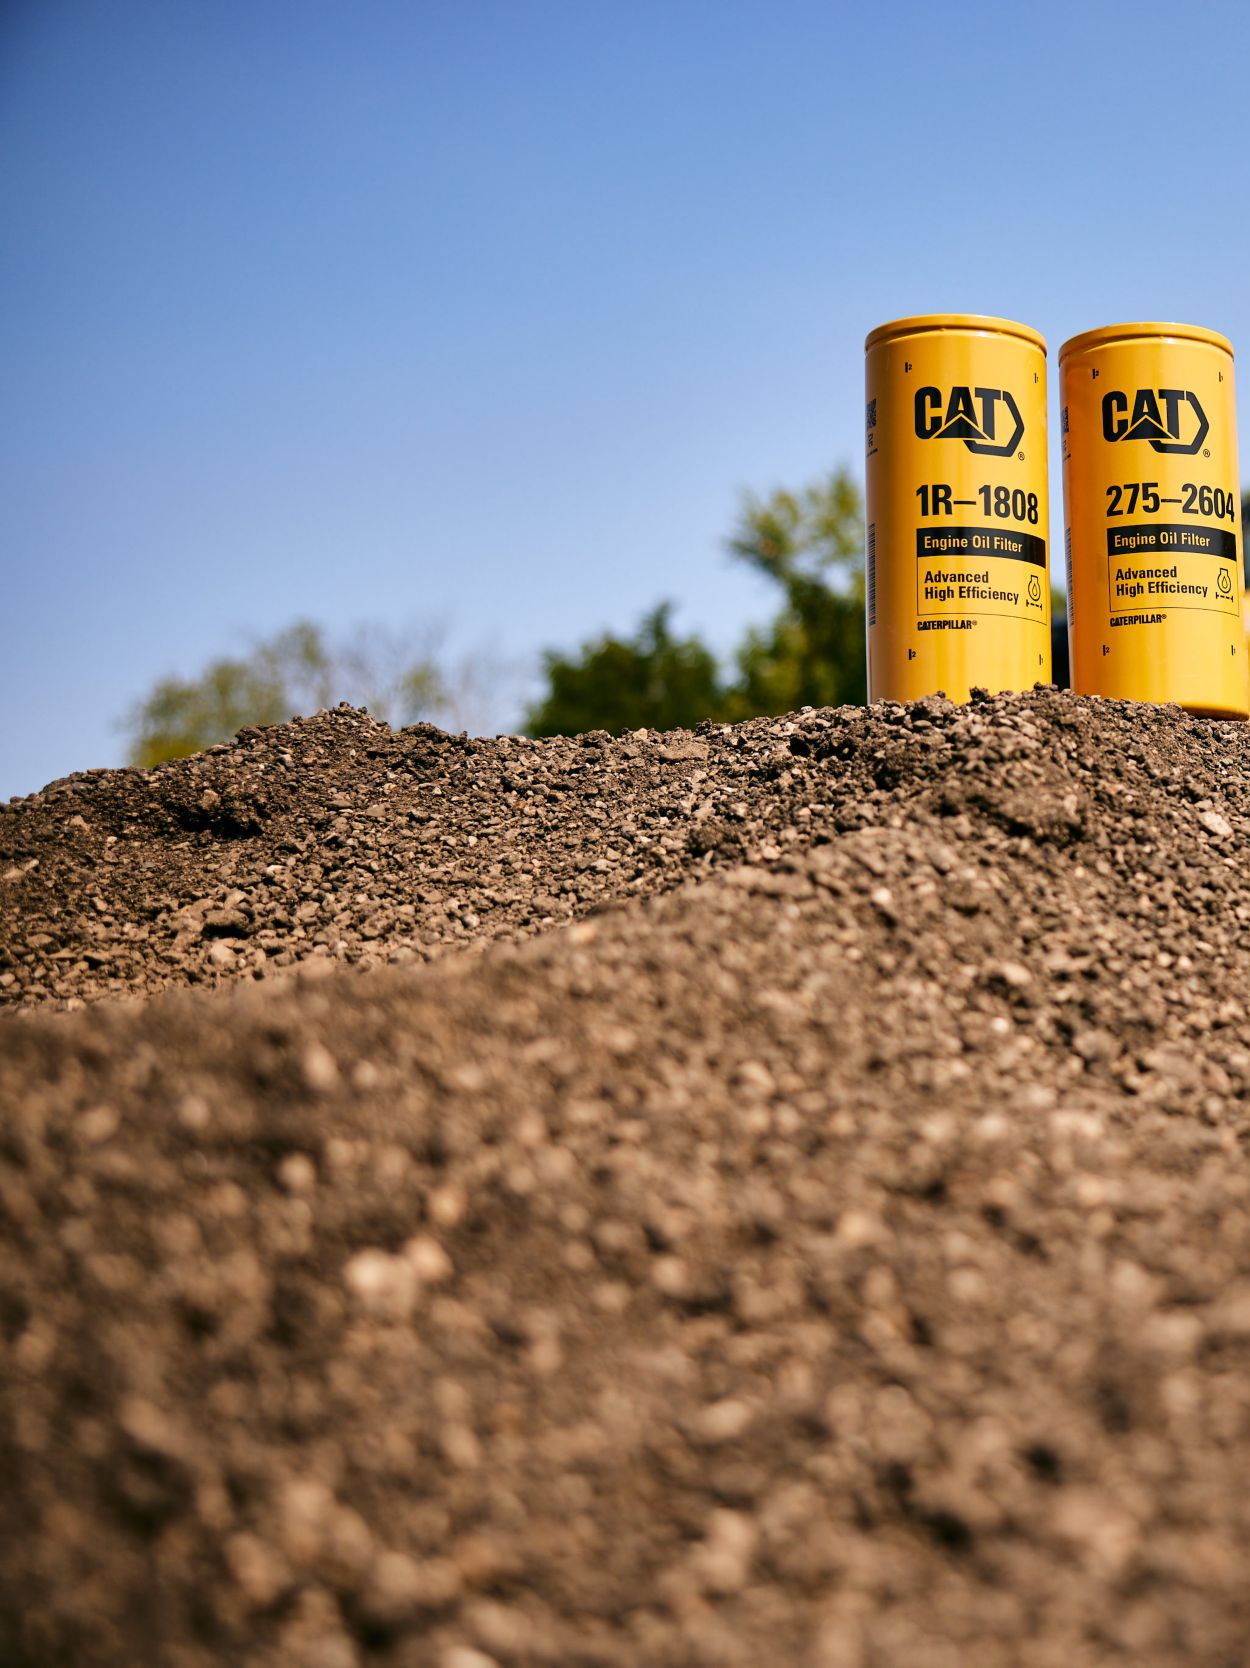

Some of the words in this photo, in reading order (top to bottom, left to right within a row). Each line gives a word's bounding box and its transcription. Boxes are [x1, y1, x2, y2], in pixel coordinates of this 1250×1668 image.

[914, 386, 1002, 441] CAT
[1101, 388, 1185, 443] CAT
[916, 484, 1039, 525] 1R-1808
[1105, 482, 1235, 523] 275-2604
[924, 535, 968, 551] Engine
[972, 535, 990, 549] Oil
[994, 537, 1023, 552] Filter
[1114, 533, 1156, 548] Engine
[1160, 531, 1177, 545] Oil
[1181, 532, 1211, 547] Filter
[924, 570, 989, 584] Advanced
[1115, 566, 1178, 581] Advanced
[924, 586, 955, 601] High
[958, 586, 1020, 605] Efficiency
[1116, 582, 1144, 597] High
[1147, 581, 1208, 598] Efficiency
